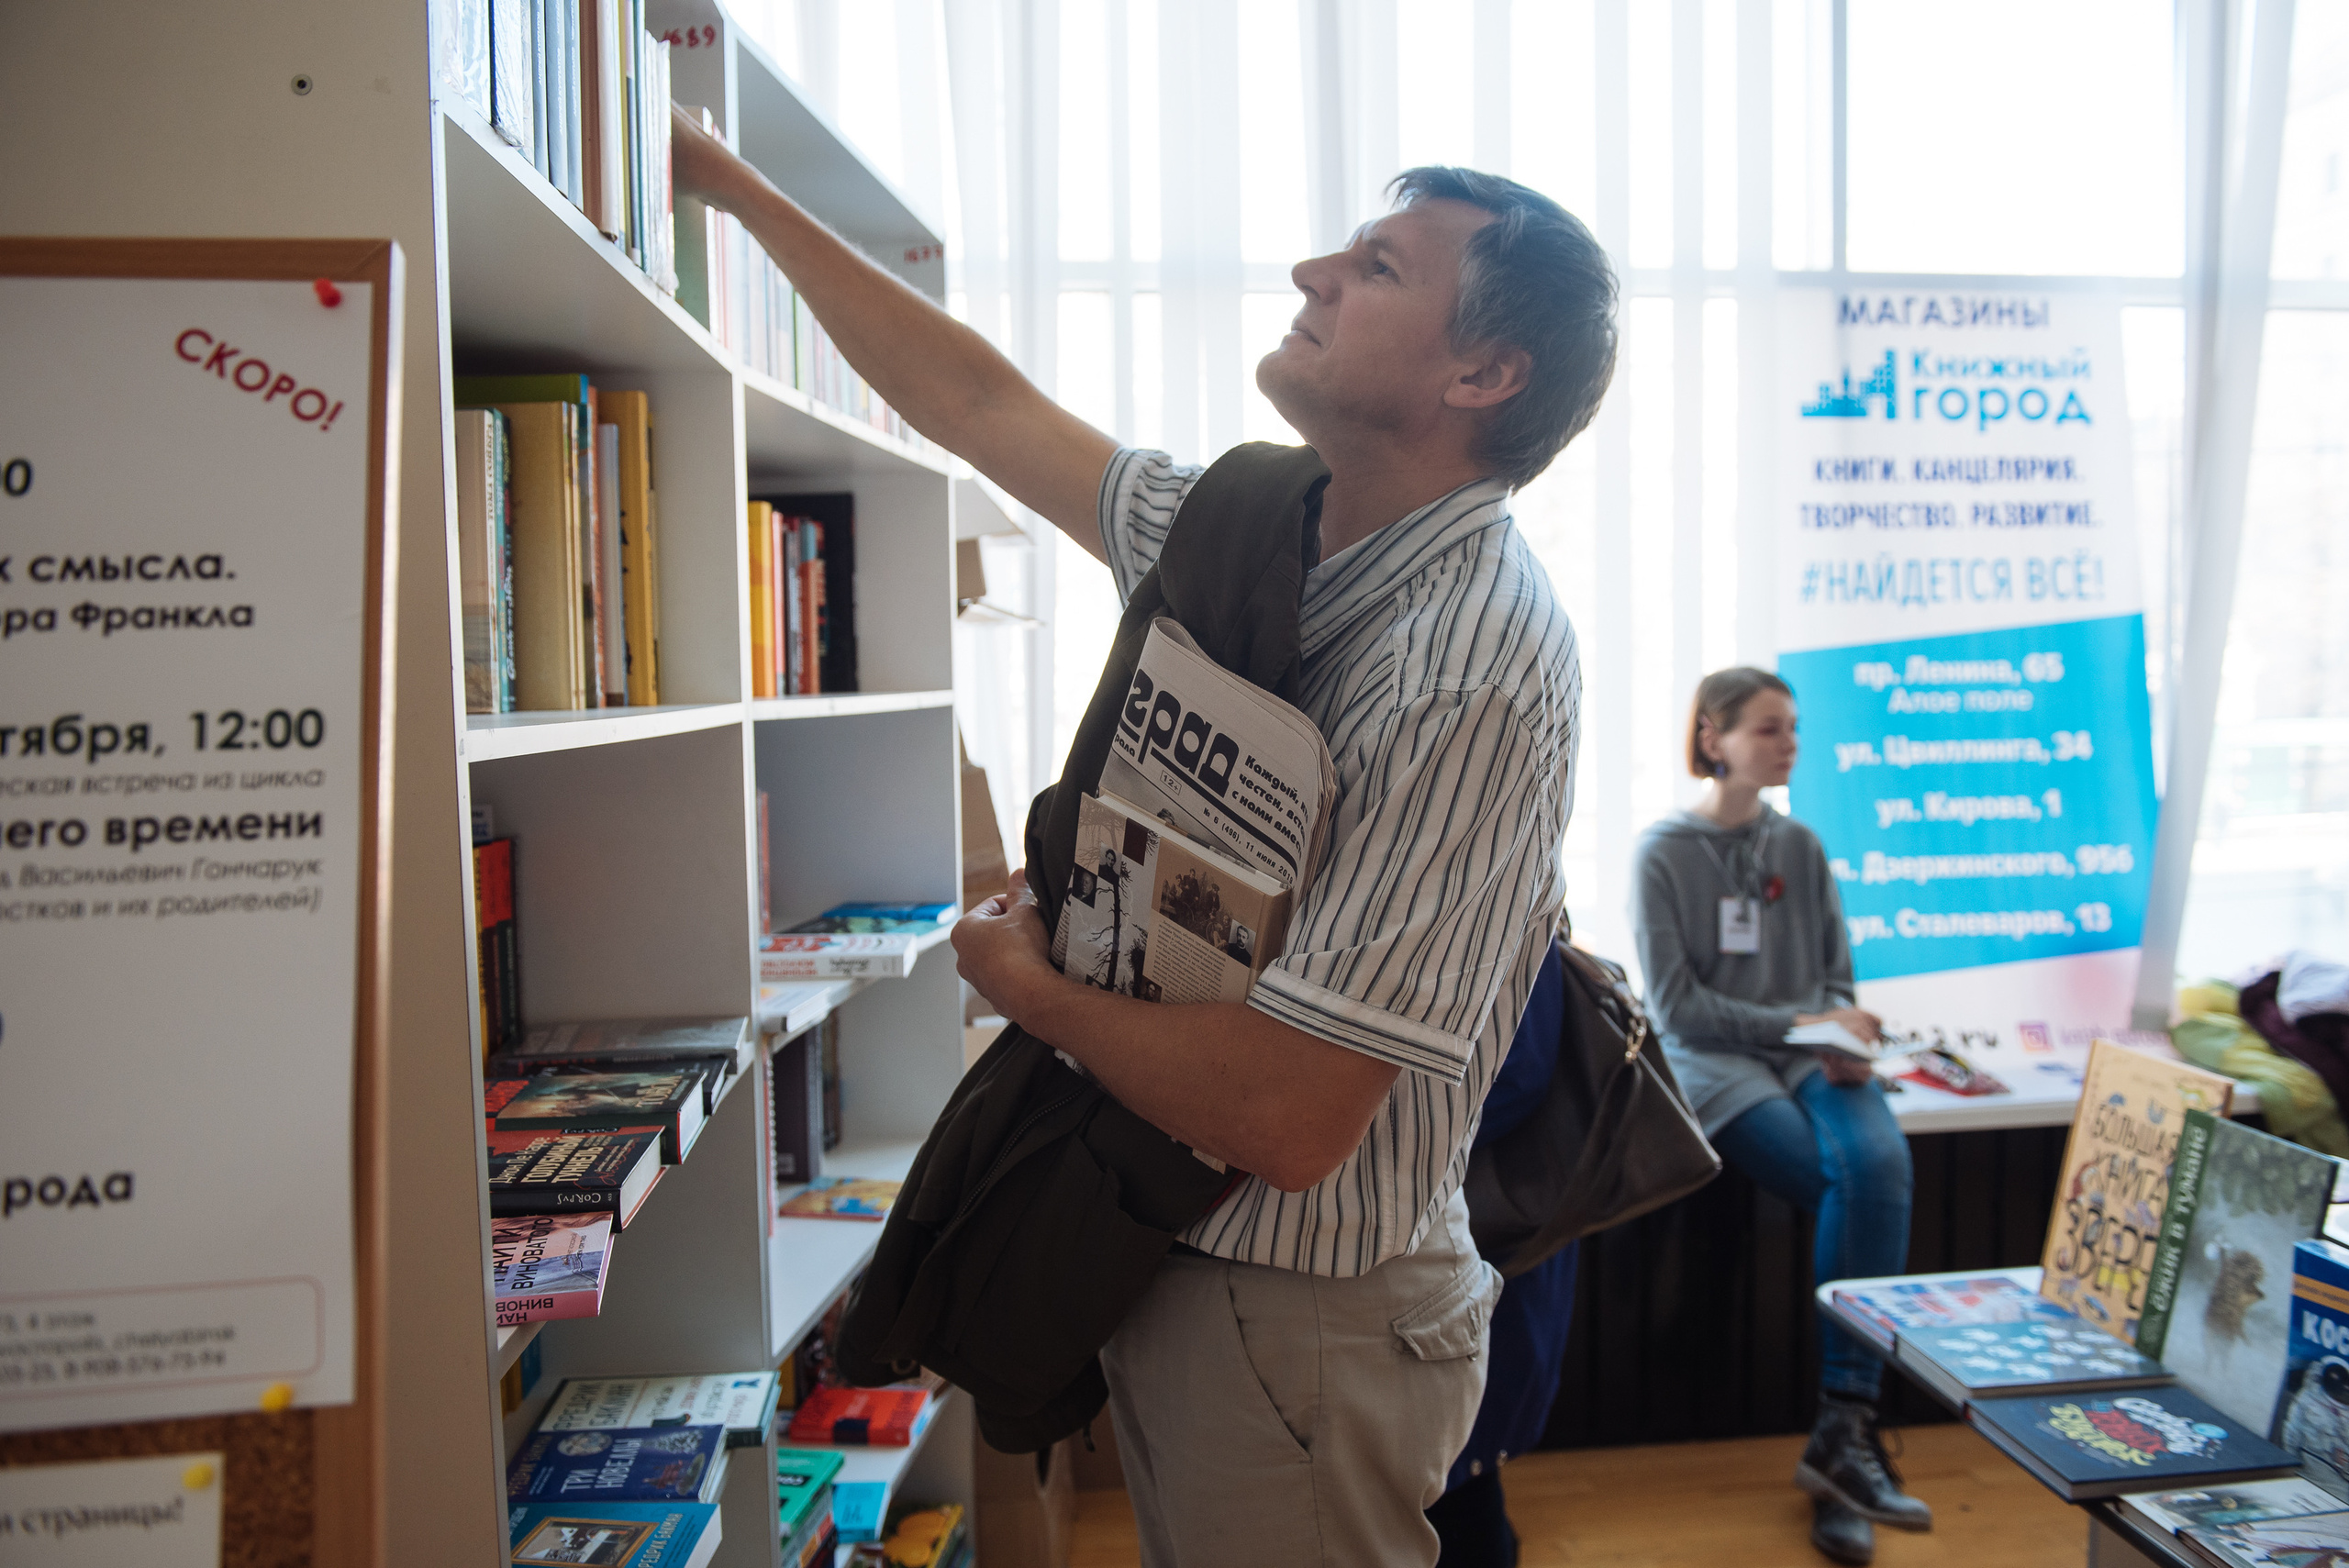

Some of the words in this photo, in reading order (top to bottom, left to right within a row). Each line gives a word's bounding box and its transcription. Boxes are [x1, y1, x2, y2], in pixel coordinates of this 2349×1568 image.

[1838, 295, 2051, 328] МАГАЗИНЫ
[175, 328, 344, 432] СКОРО!
[1914, 388, 2093, 433] город
[28, 553, 237, 583] смысла.
[70, 600, 255, 637] Франкла
[2022, 652, 2065, 684] 65
[190, 707, 325, 751] 12:00
[2052, 730, 2094, 762] 34
[81, 772, 197, 798] встреча
[202, 772, 236, 791] из
[239, 768, 326, 791] цикла
[1163, 774, 1180, 792] 12+
[1239, 773, 1284, 812] честен,
[1244, 754, 1299, 805] Каждый,
[1231, 790, 1239, 800] с
[1239, 795, 1273, 824] нами
[2043, 787, 2063, 818] 1
[0, 817, 88, 849] его
[104, 811, 325, 853] времени
[1213, 816, 1219, 824] 6
[1256, 850, 1275, 868] июня
[190, 856, 323, 884] Гончарук
[520, 1135, 586, 1184] ГОЛУБИНЫЙ
[551, 1146, 604, 1184] ТУННЕЛЬ
[2, 1171, 134, 1218] рода
[511, 1217, 554, 1290] ВИНОВАТОГО
[560, 1466, 599, 1494] ТРИ
